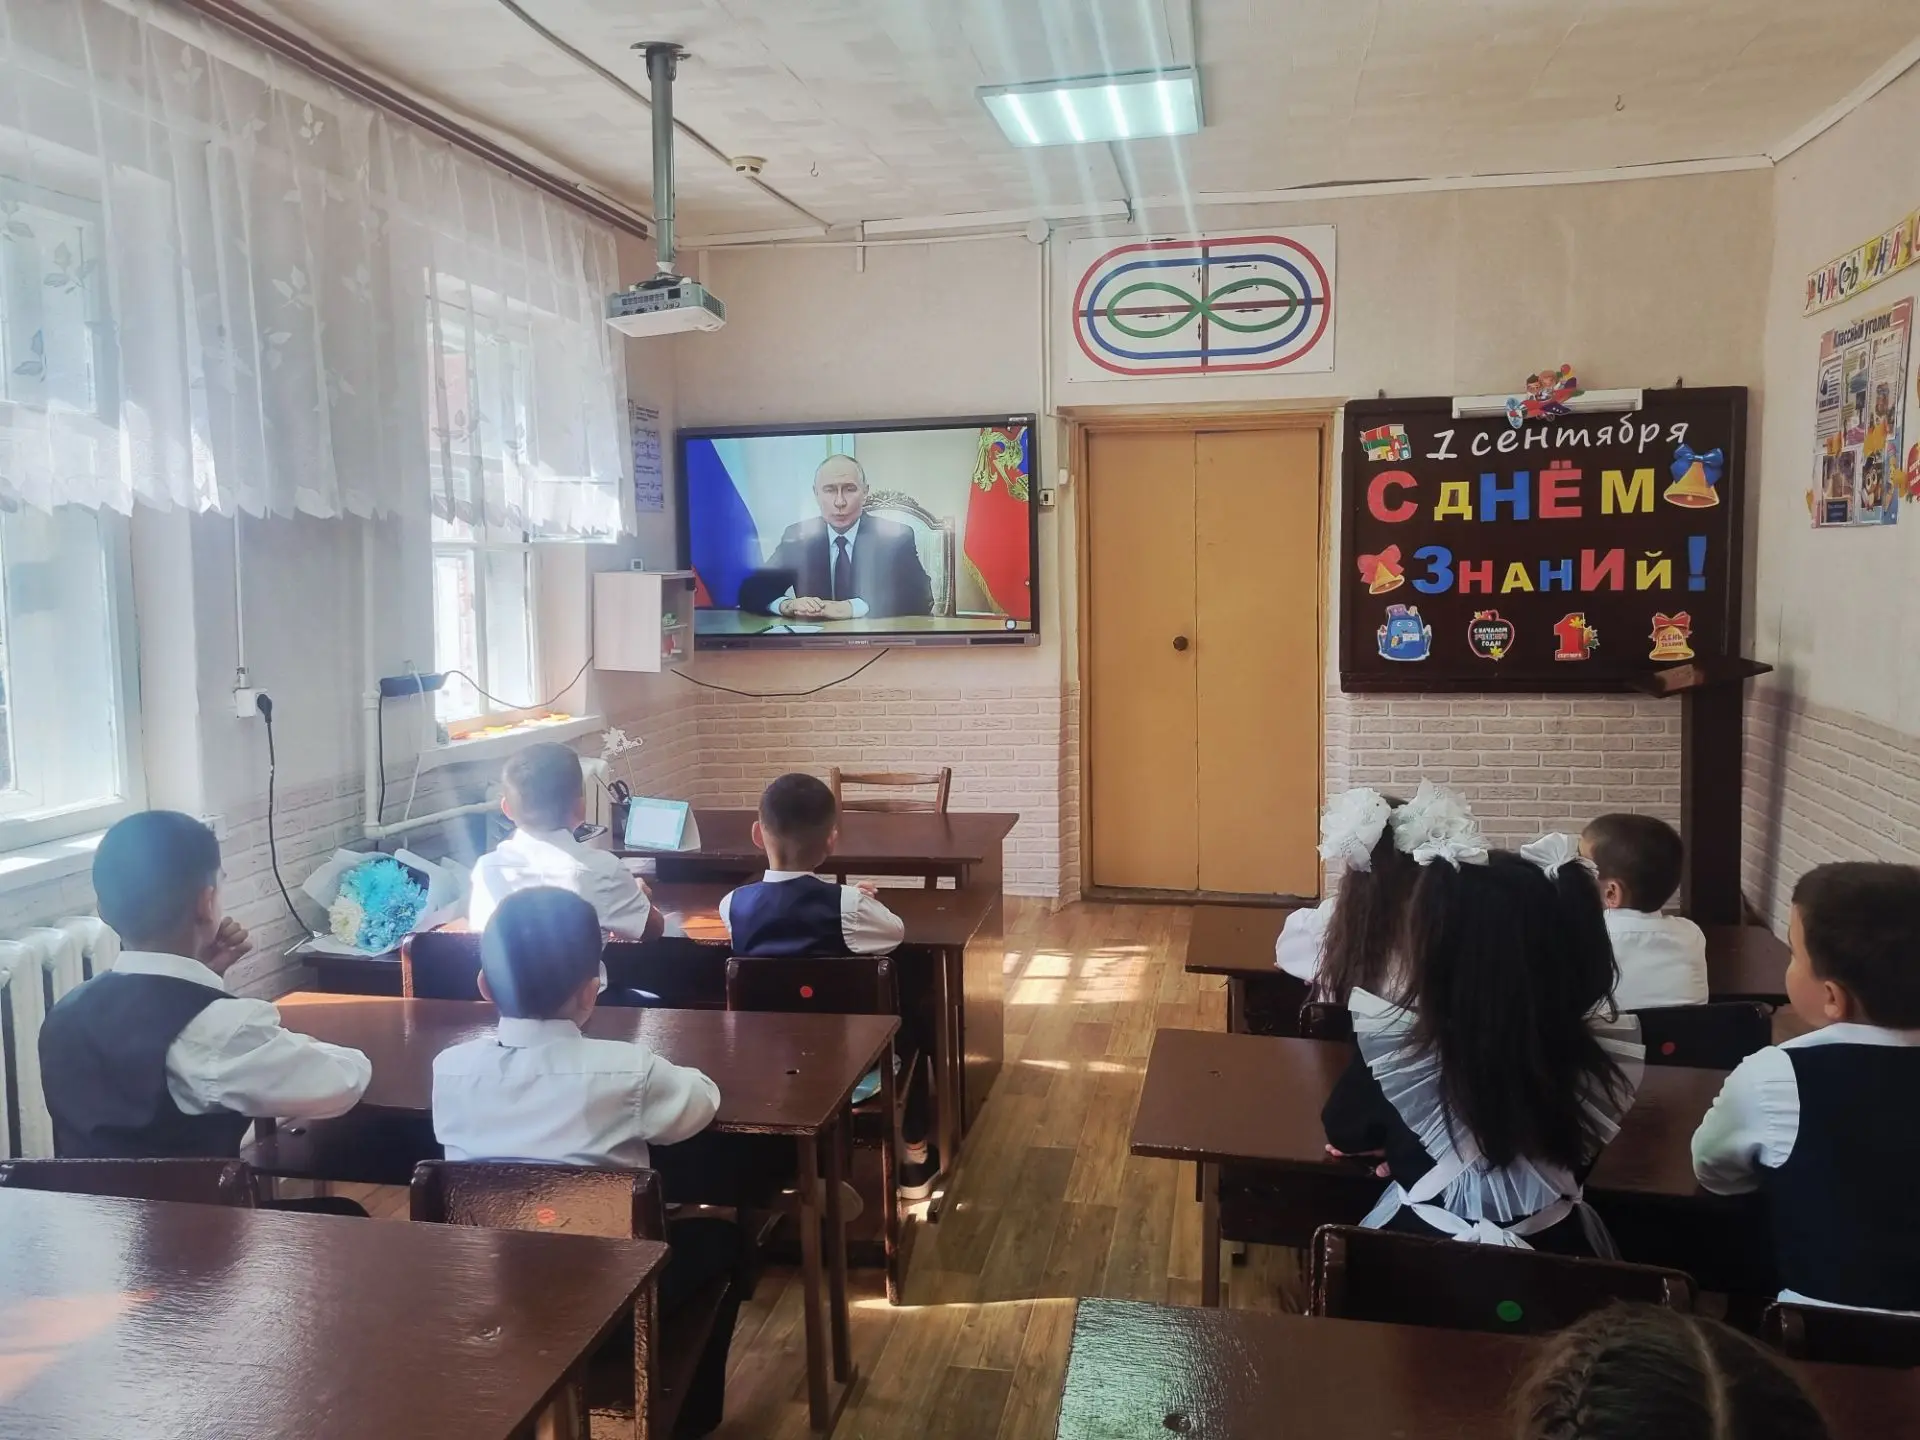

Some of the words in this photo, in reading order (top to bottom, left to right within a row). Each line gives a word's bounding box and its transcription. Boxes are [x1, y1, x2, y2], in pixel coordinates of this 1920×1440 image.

[1426, 429, 1458, 460] 1
[1471, 413, 1689, 455] сентября
[1367, 470, 1419, 523] С
